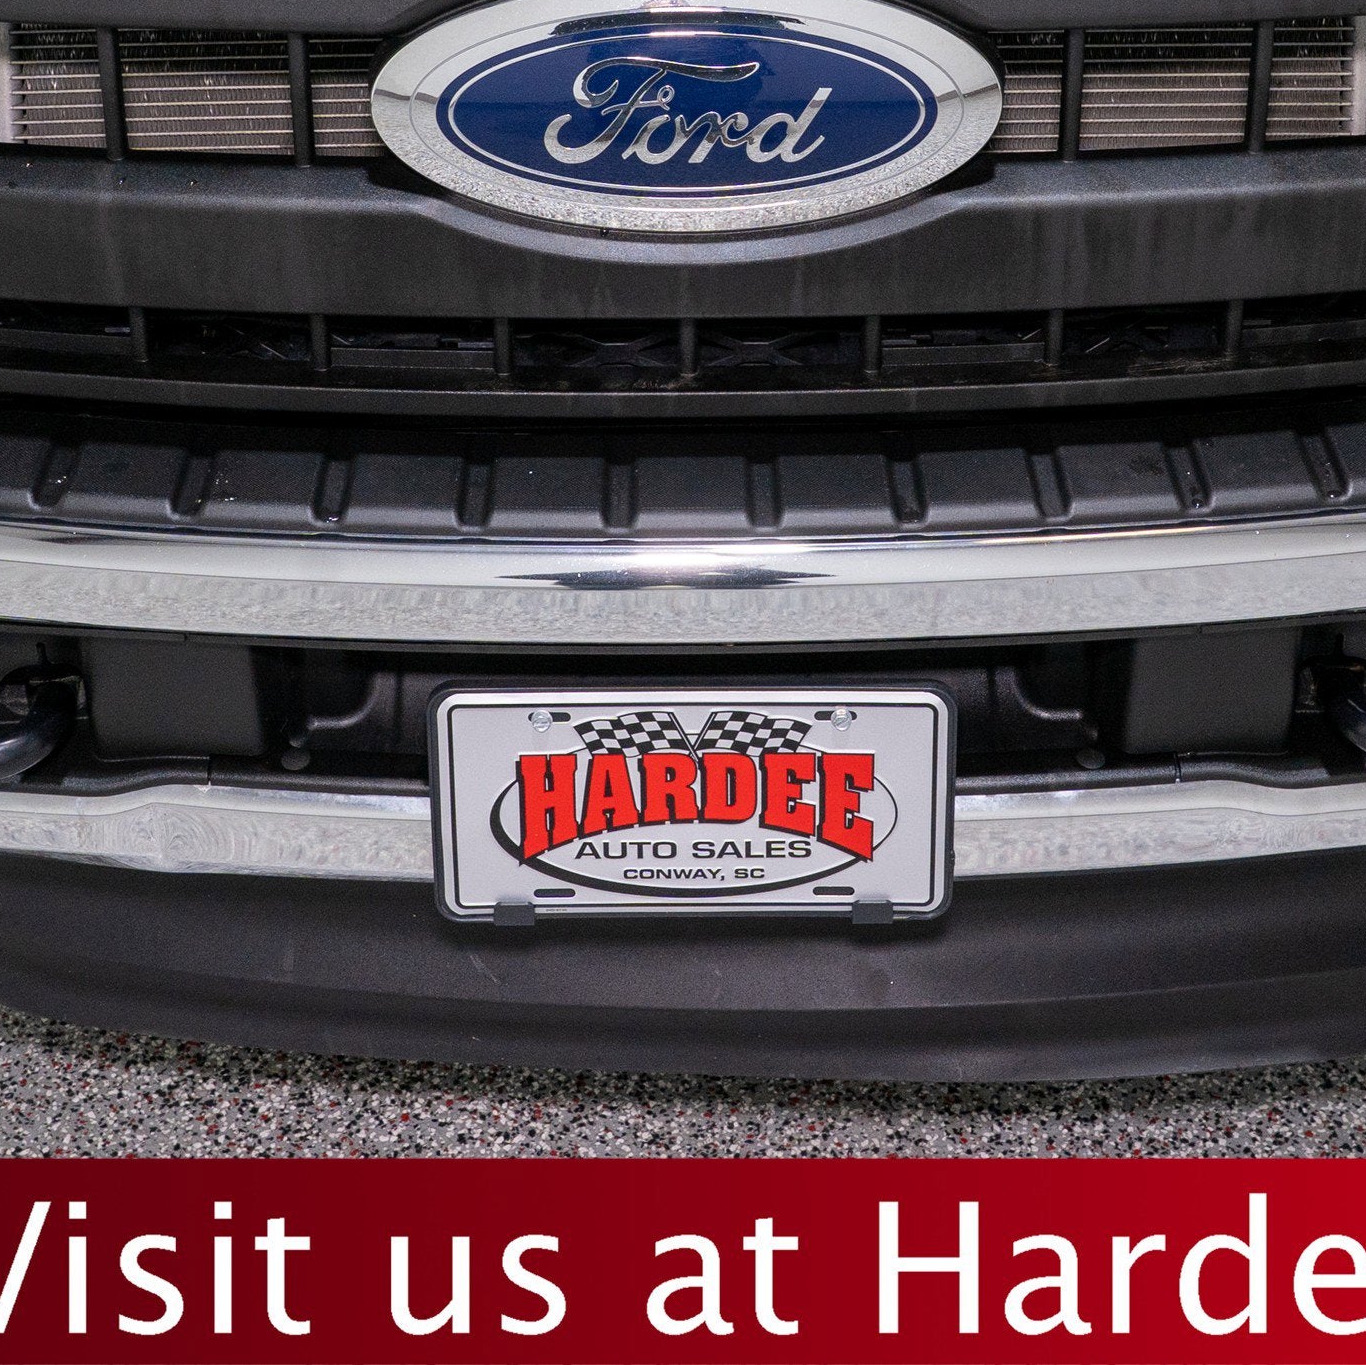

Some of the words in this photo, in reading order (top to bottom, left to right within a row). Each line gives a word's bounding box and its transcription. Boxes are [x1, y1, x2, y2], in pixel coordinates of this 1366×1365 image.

[543, 55, 834, 165] Ford
[515, 752, 875, 865] HARDEE
[574, 838, 677, 860] AUTO
[691, 838, 813, 859] SALES
[622, 868, 726, 881] CONWAY,
[733, 868, 766, 880] SC
